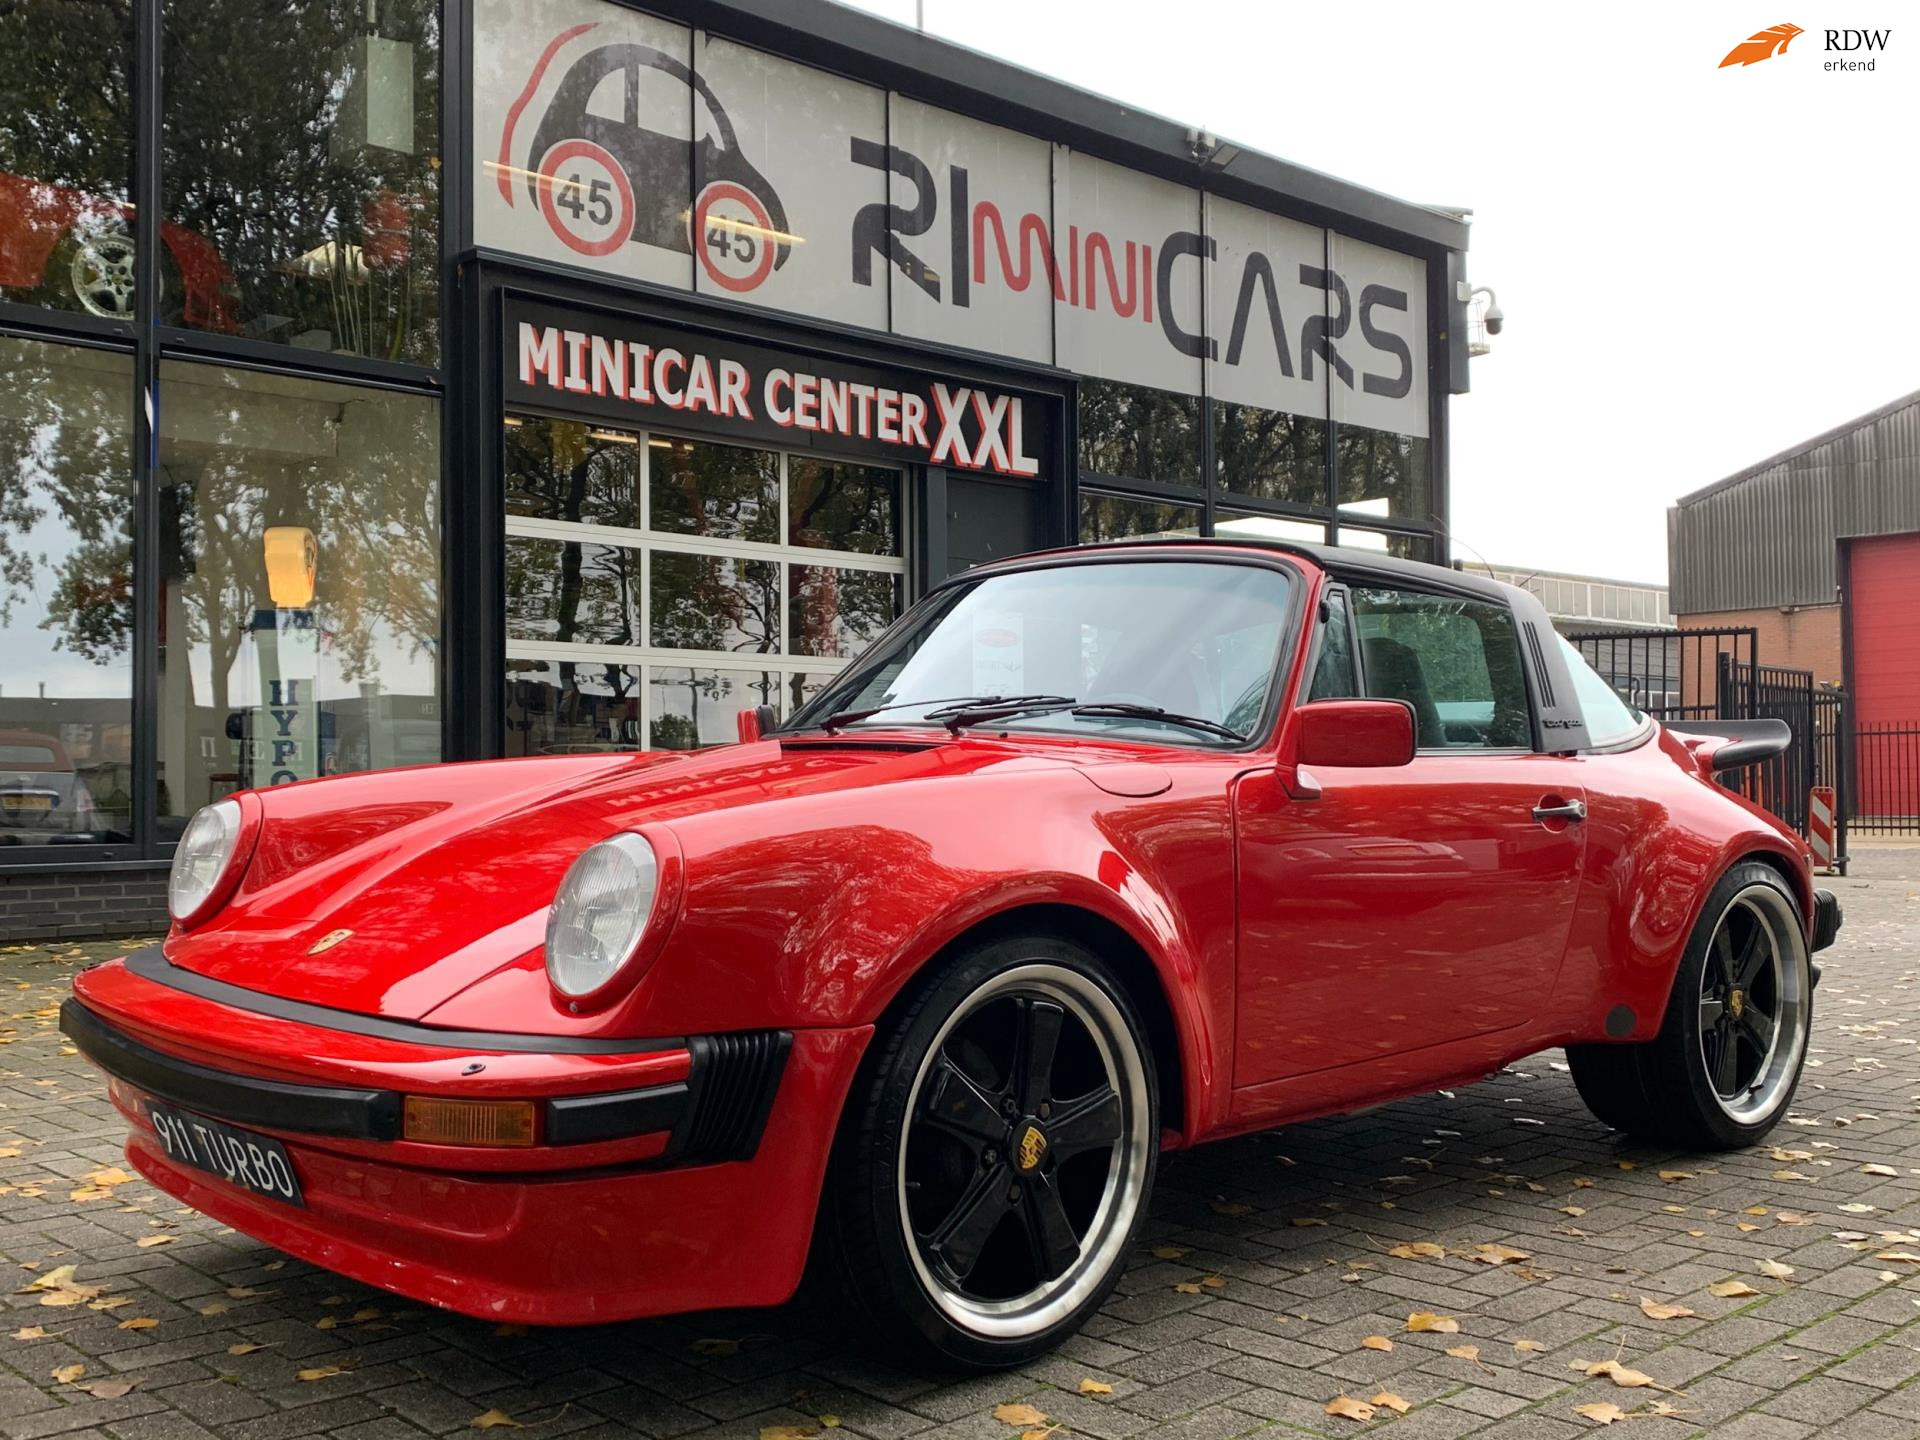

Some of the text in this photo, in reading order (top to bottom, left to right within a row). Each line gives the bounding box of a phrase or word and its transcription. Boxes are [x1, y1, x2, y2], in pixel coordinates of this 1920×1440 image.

[556, 173, 613, 226] 45
[707, 214, 757, 264] 45
[518, 321, 1039, 478] MINICAR CENTER XXL
[151, 1111, 294, 1198] 911 TURBO
